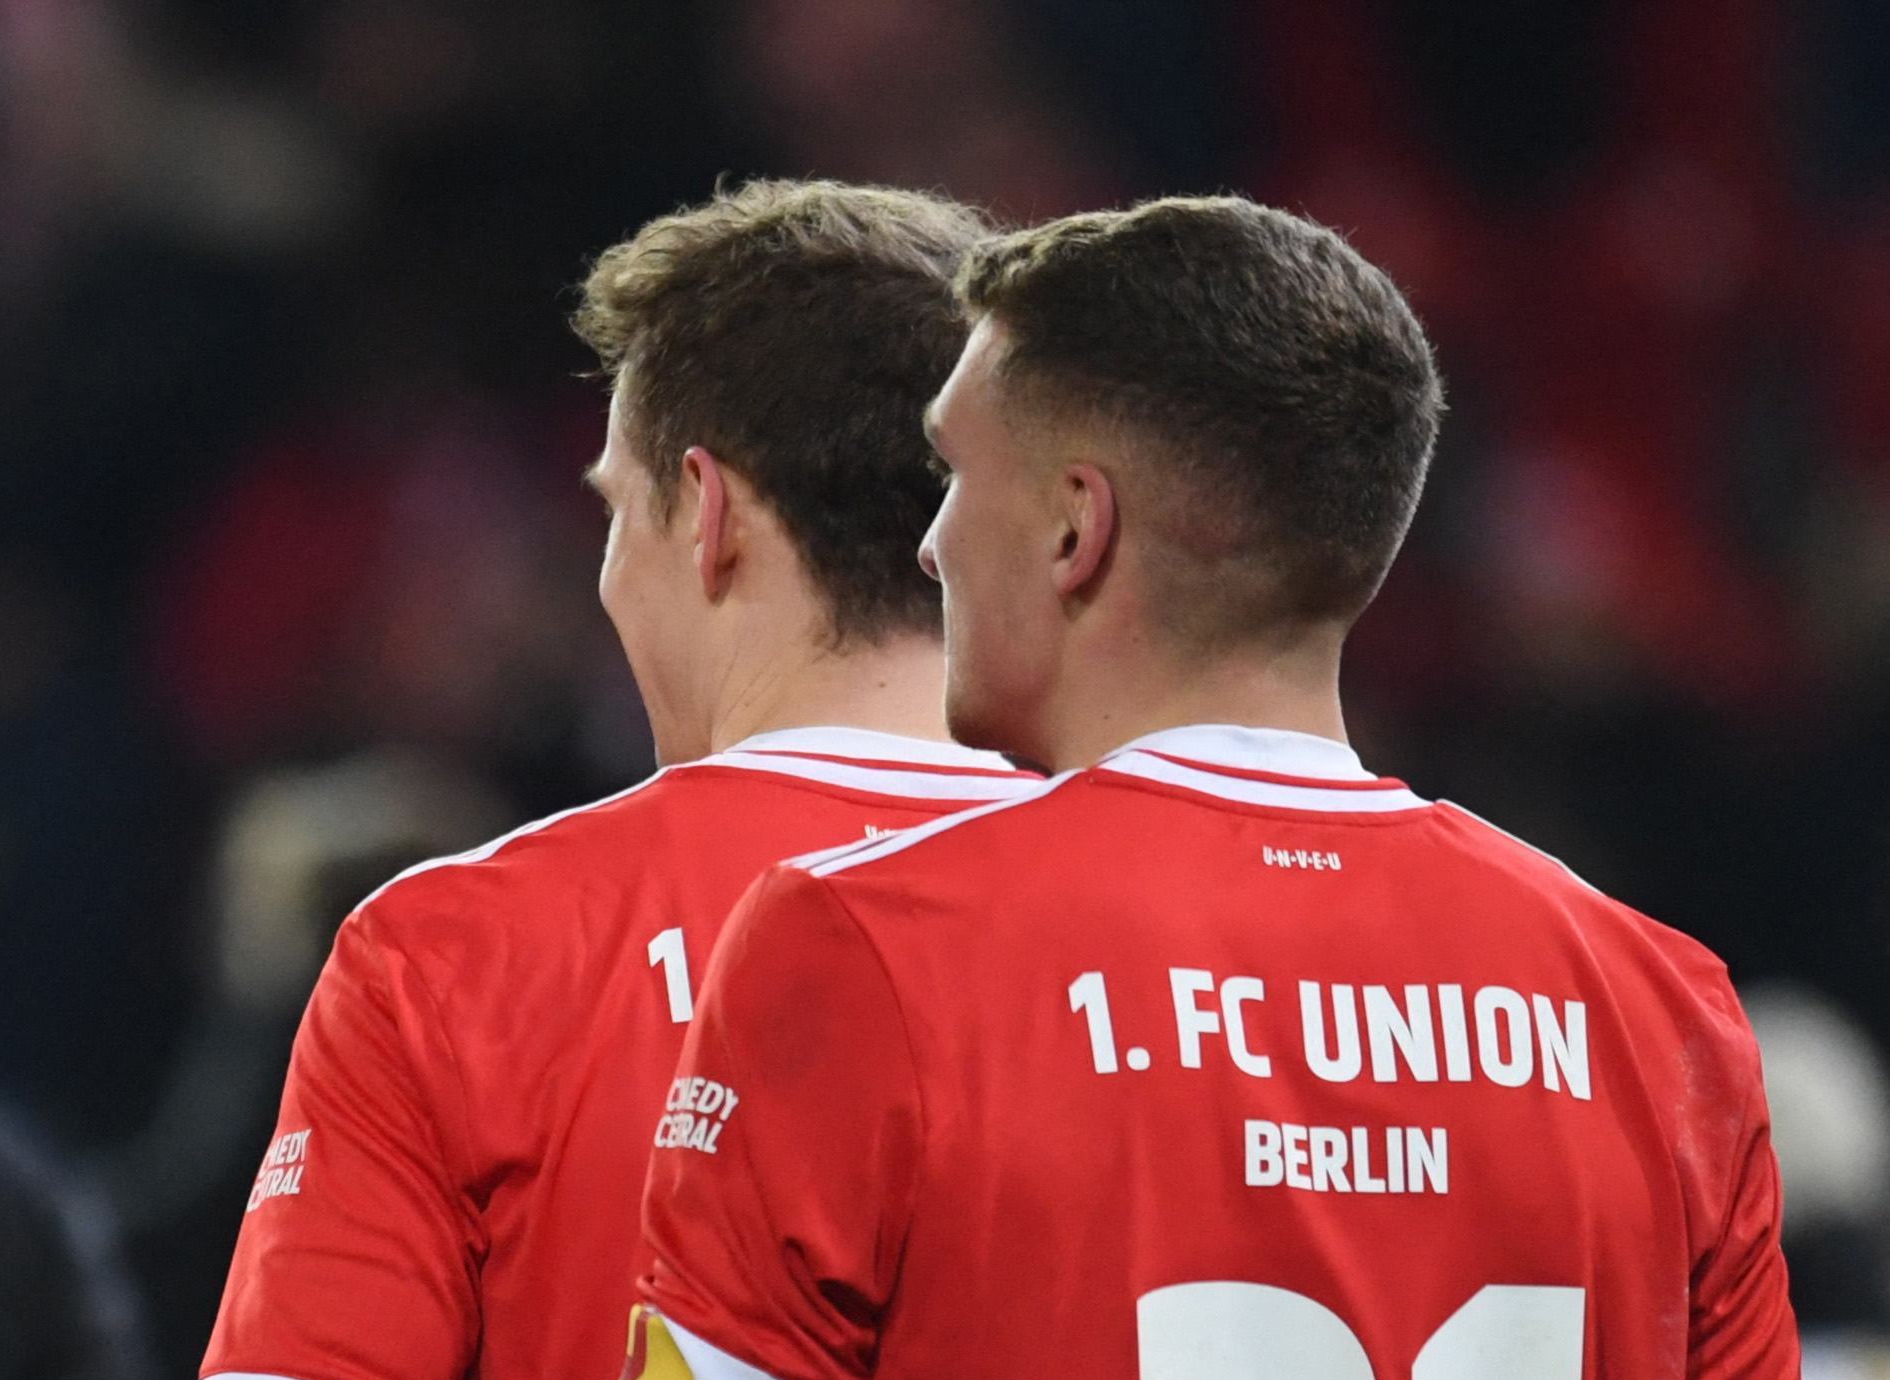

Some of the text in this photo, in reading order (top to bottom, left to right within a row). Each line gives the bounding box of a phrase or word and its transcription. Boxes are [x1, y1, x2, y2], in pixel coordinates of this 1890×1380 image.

[1068, 967, 1592, 1101] 1. FC UNION
[1244, 1119, 1448, 1194] BERLIN
